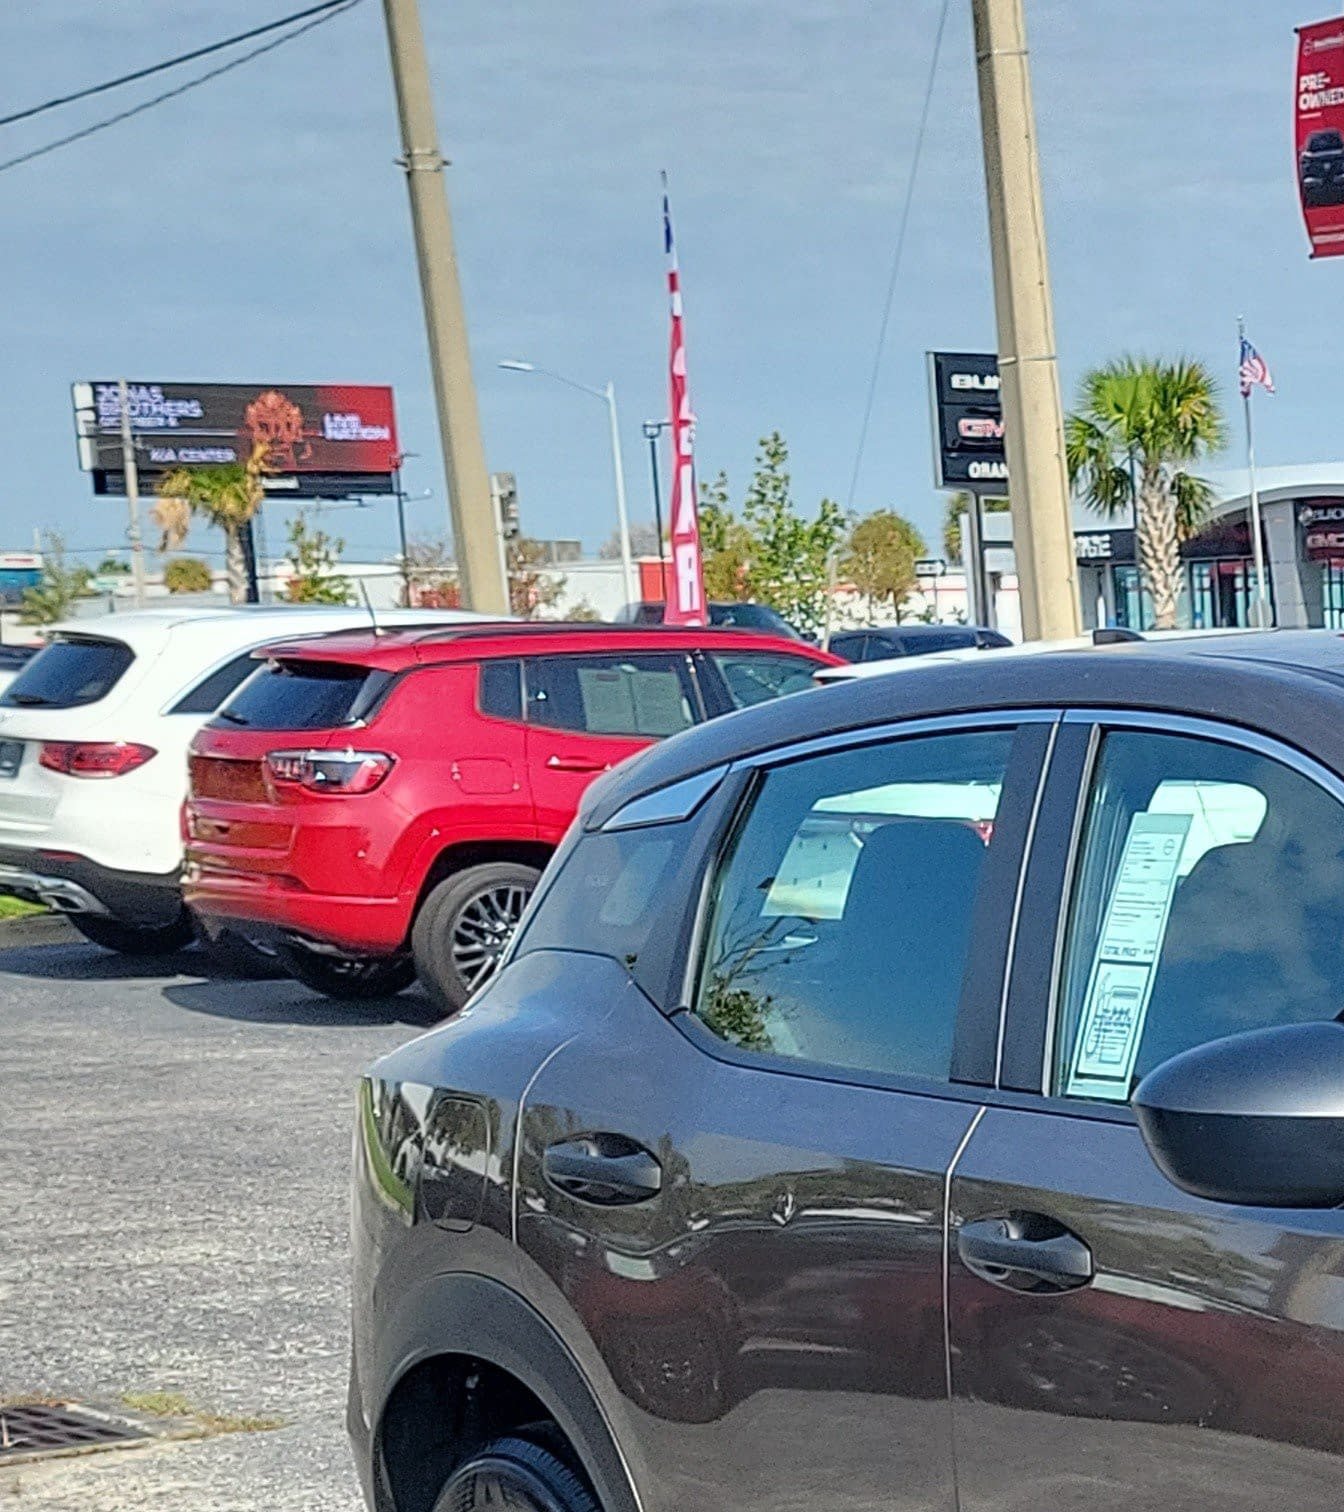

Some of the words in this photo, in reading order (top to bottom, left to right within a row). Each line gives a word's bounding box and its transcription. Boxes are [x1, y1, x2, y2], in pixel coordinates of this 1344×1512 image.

[1300, 71, 1331, 92] PRE-
[950, 374, 1001, 390] BUI
[958, 418, 1005, 438] GM
